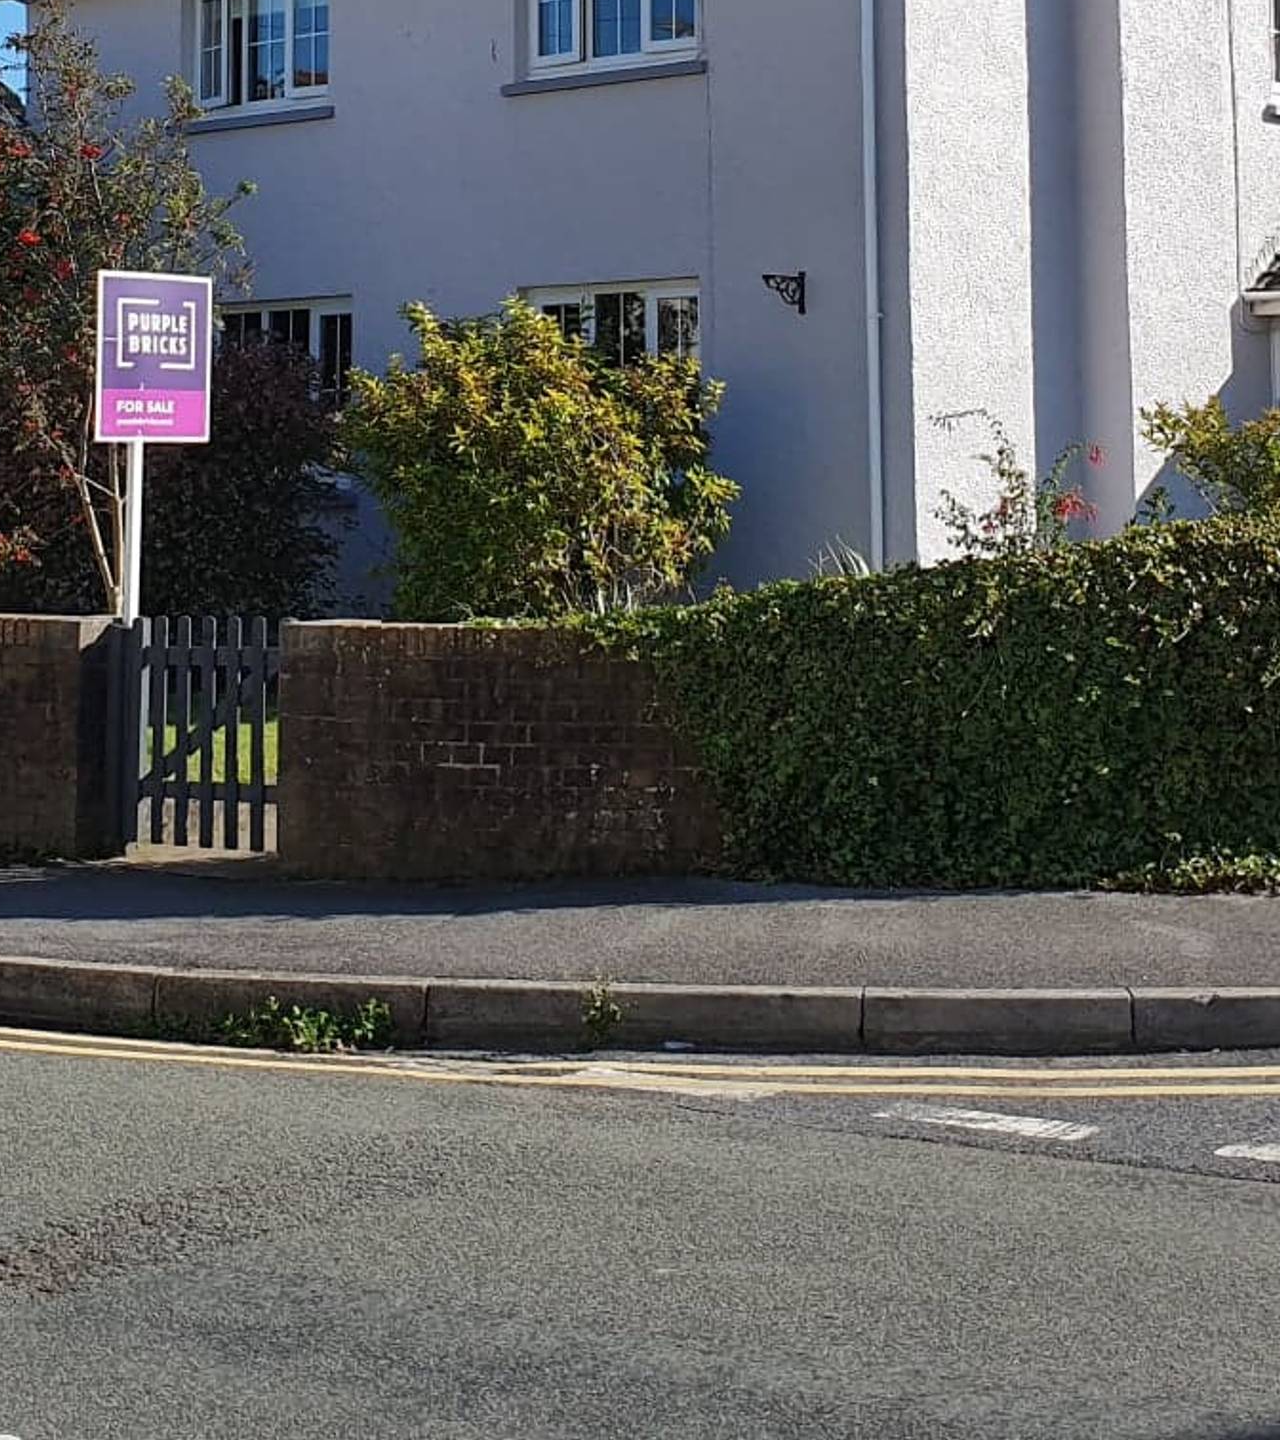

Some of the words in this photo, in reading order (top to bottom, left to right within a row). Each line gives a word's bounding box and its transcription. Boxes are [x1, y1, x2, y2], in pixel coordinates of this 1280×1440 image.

[128, 312, 188, 333] PURPLE
[128, 335, 187, 355] BRICKS
[116, 400, 143, 413] FOR
[147, 401, 175, 414] SALE
